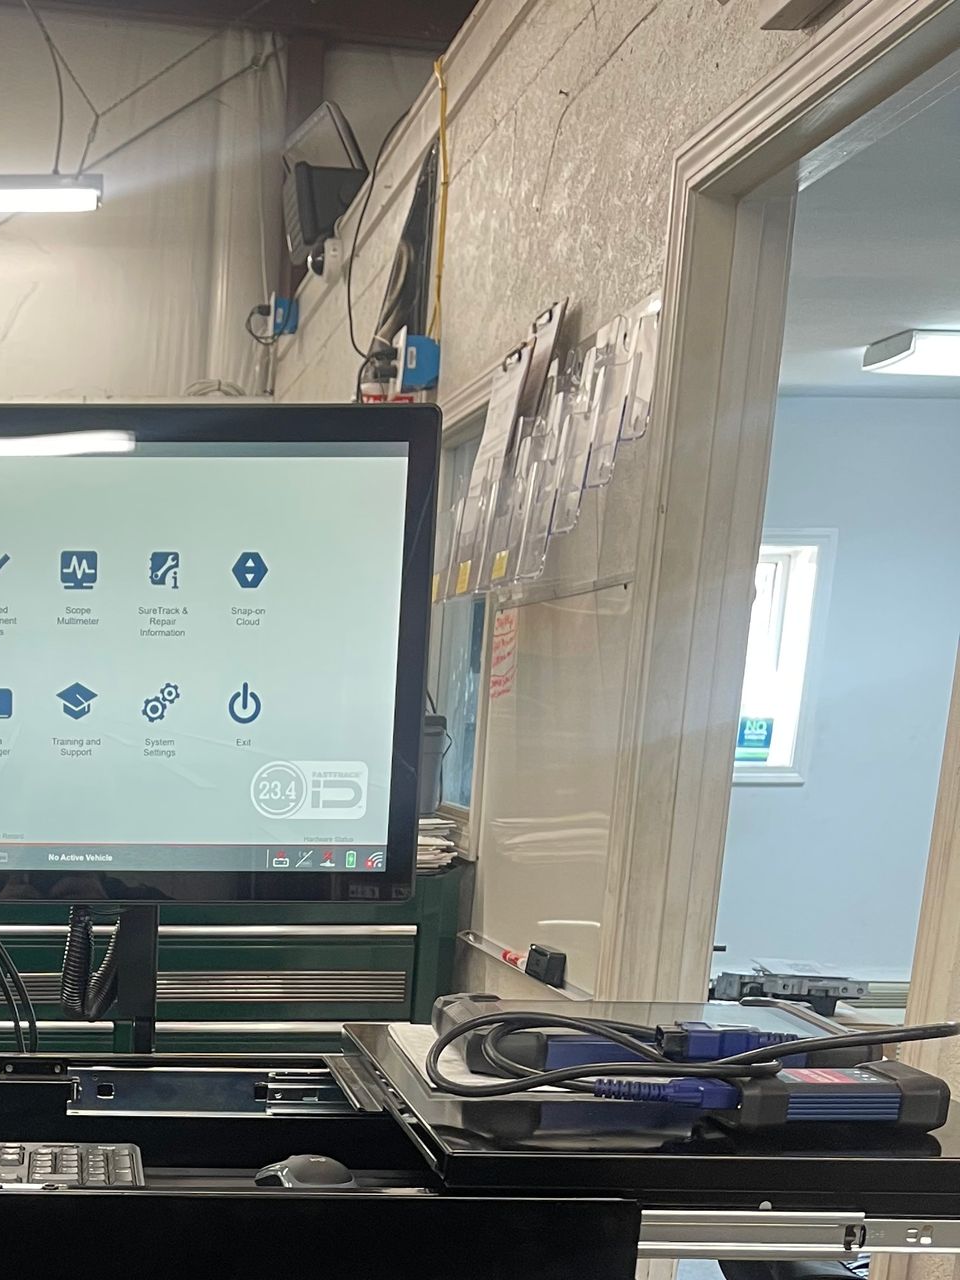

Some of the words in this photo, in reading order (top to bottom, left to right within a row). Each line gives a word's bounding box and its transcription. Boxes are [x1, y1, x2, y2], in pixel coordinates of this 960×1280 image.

[65, 606, 91, 616] Scope
[138, 606, 180, 615] SureTrack
[181, 606, 188, 615] &
[230, 607, 266, 617] Snap-on
[56, 617, 99, 626] Multimeter
[149, 617, 176, 628] Repair
[236, 617, 260, 626] Cloud
[139, 628, 186, 637] Information
[52, 737, 84, 747] Training
[85, 737, 101, 746] and
[144, 738, 175, 748] System
[236, 738, 251, 747] Exit
[60, 748, 92, 757] Support
[143, 748, 176, 758] Settings
[258, 780, 297, 800] 23.4
[48, 853, 59, 861] No
[60, 853, 85, 861] Active
[85, 854, 113, 862] Vehicle
